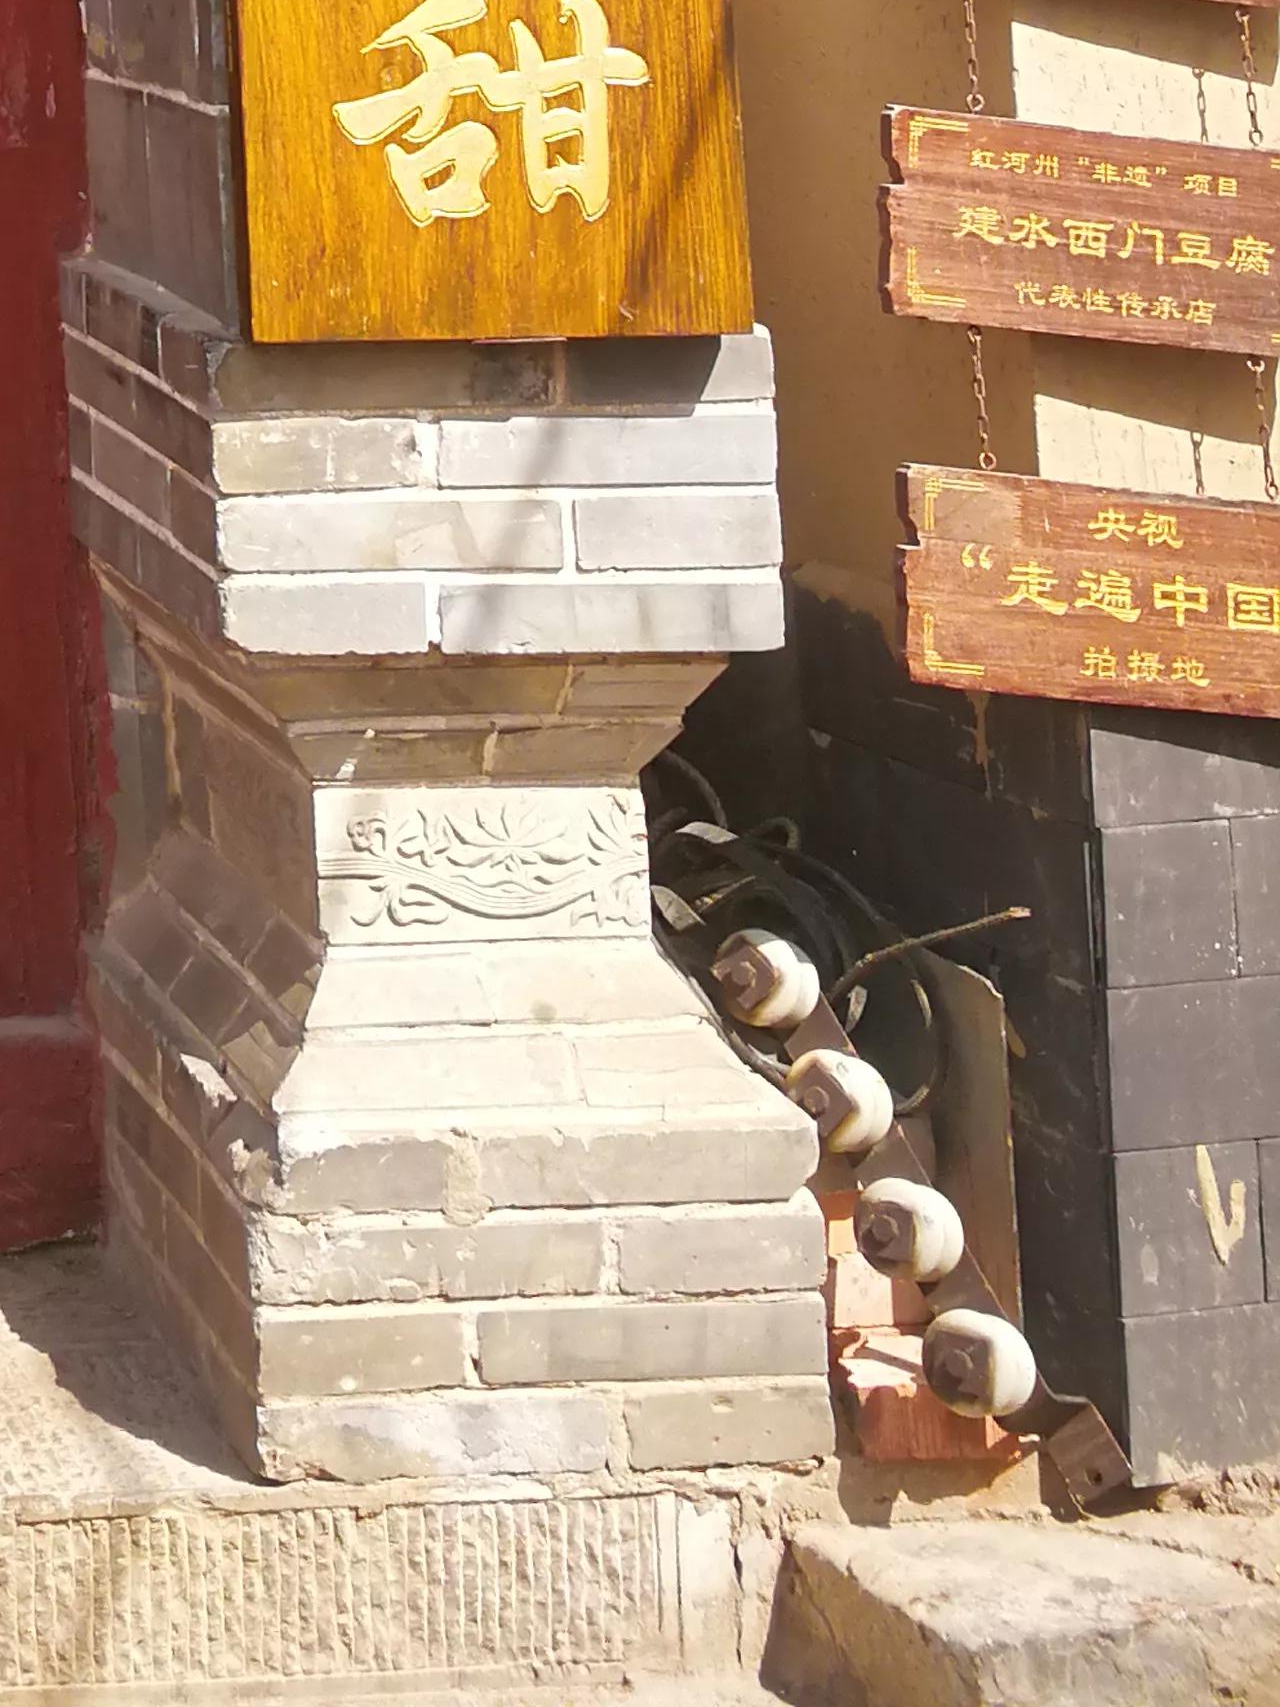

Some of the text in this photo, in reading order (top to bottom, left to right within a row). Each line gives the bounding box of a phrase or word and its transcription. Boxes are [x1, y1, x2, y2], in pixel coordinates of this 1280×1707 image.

[952, 204, 1276, 277] 建水西门豆腐
[1013, 280, 1218, 326] 代表性传承店
[1087, 507, 1184, 550] 央视
[1080, 645, 1211, 688] 拍摄地
